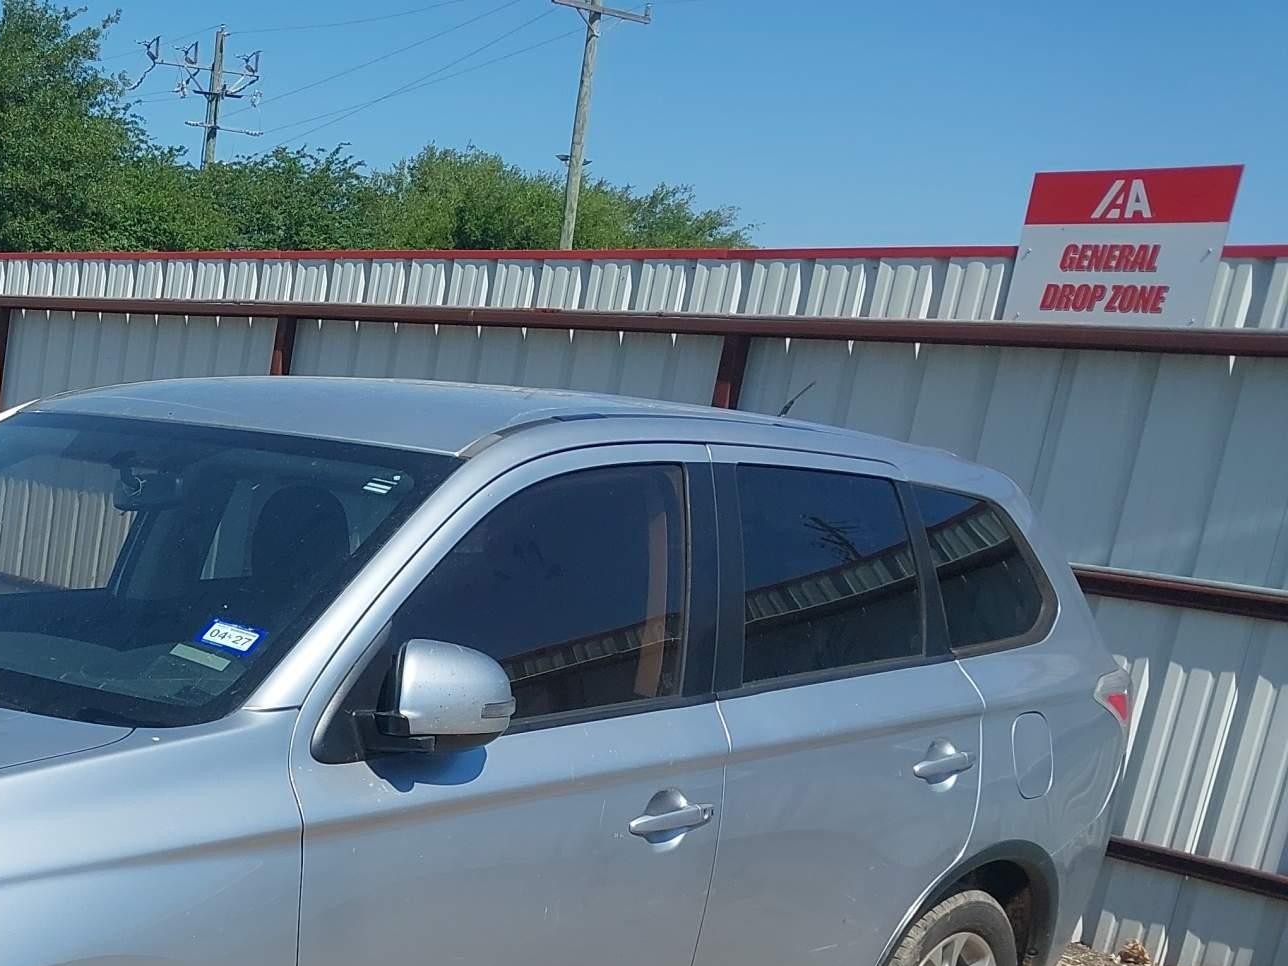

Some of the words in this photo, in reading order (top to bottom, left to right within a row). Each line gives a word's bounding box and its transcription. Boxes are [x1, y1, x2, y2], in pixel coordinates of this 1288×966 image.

[1059, 244, 1162, 273] GENERAL
[1039, 284, 1106, 312] DROP
[1103, 285, 1170, 314] ZONE
[209, 629, 229, 640] 04
[231, 635, 253, 646] 27
